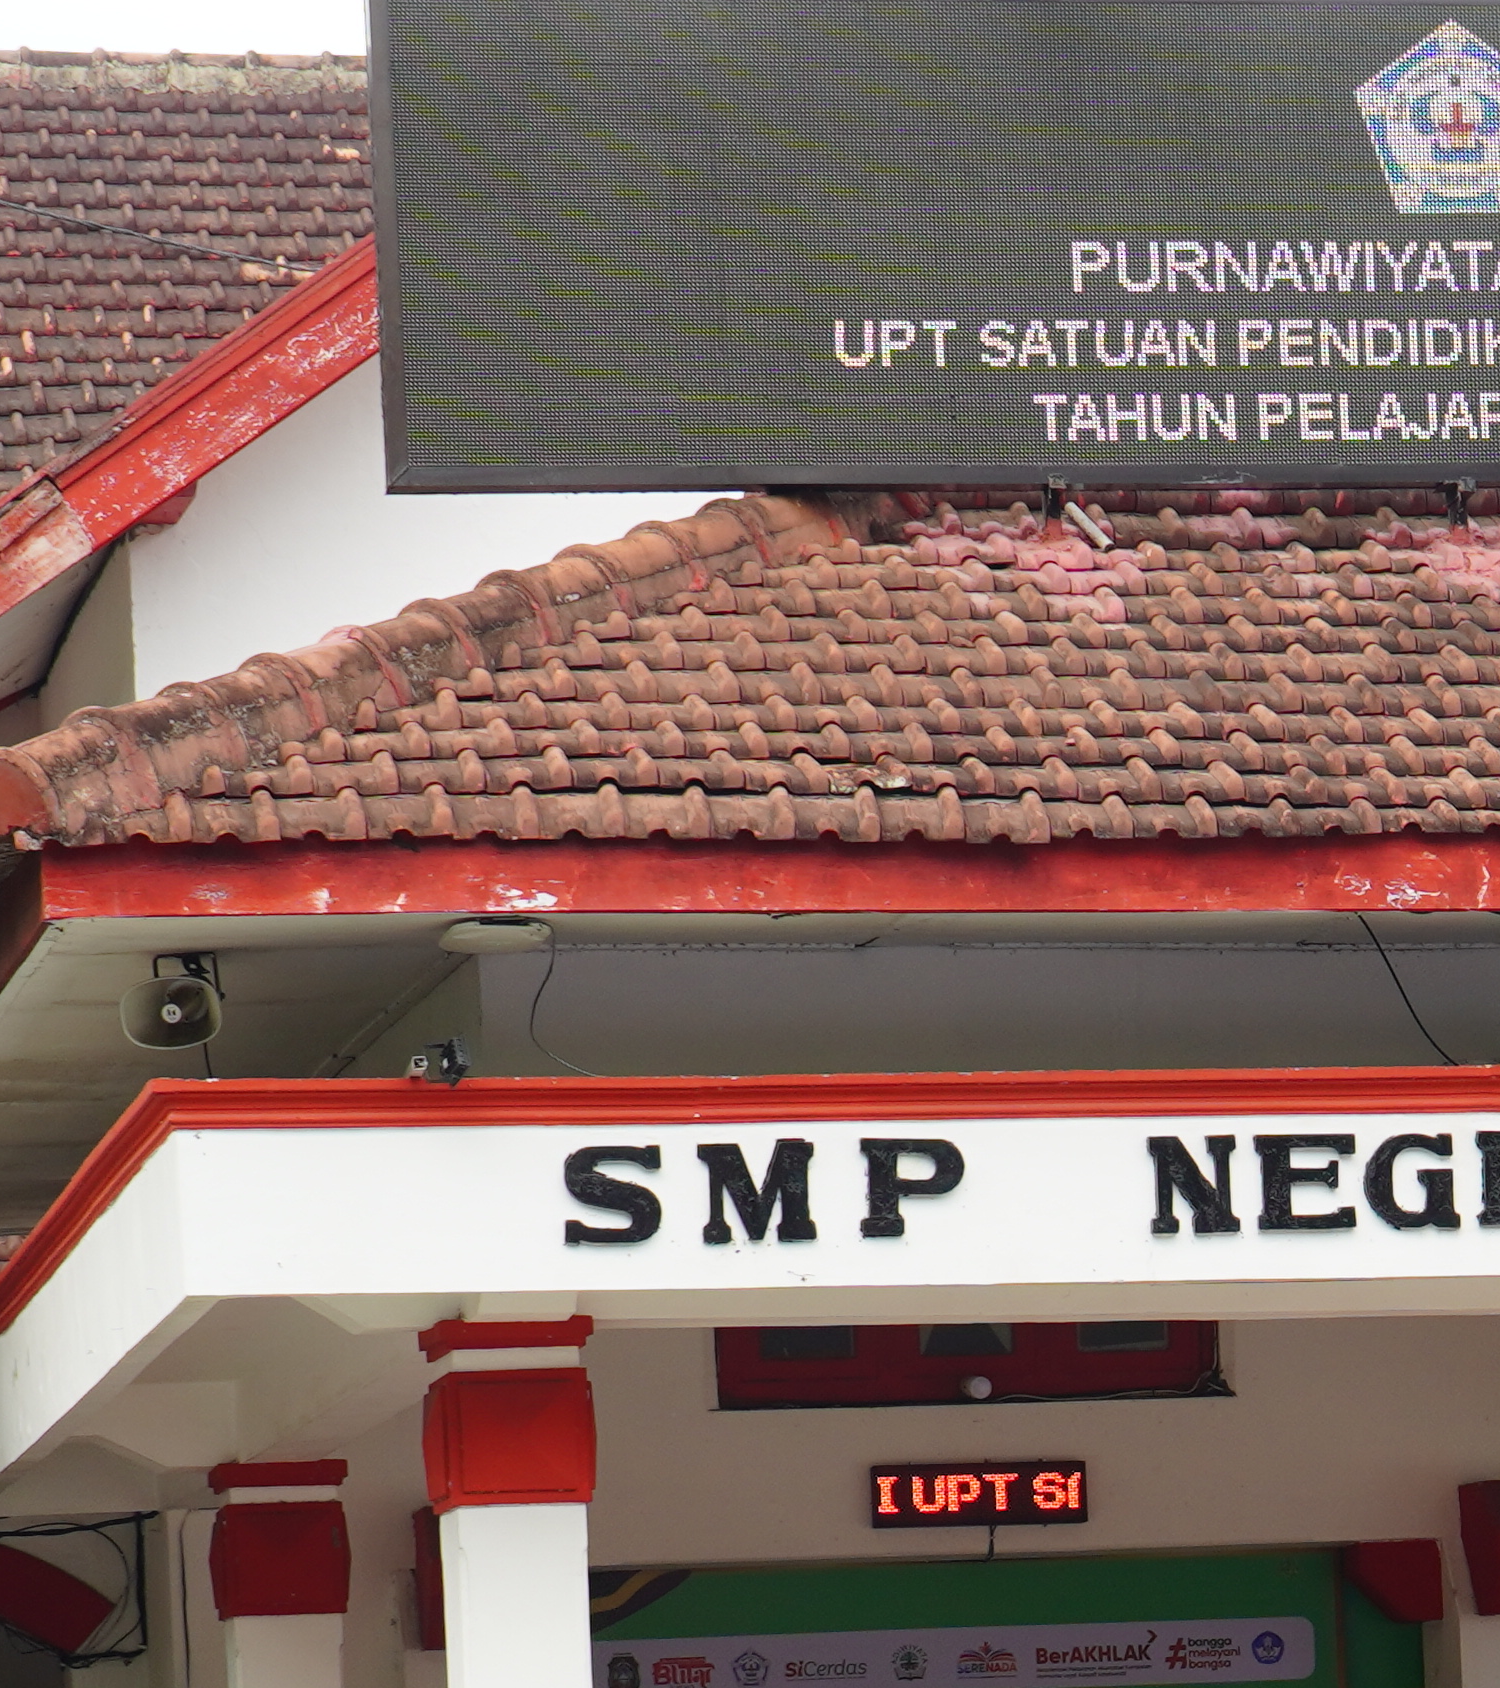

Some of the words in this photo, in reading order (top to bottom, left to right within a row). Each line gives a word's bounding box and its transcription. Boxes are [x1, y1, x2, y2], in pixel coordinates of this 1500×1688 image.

[832, 319, 957, 368] UPT
[978, 318, 1217, 367] SATUAN
[1031, 393, 1237, 442] TAHUN
[563, 1138, 966, 1246] SMP
[911, 1473, 1019, 1513] UPT
[1035, 1644, 1152, 1665] BerAKHLAK
